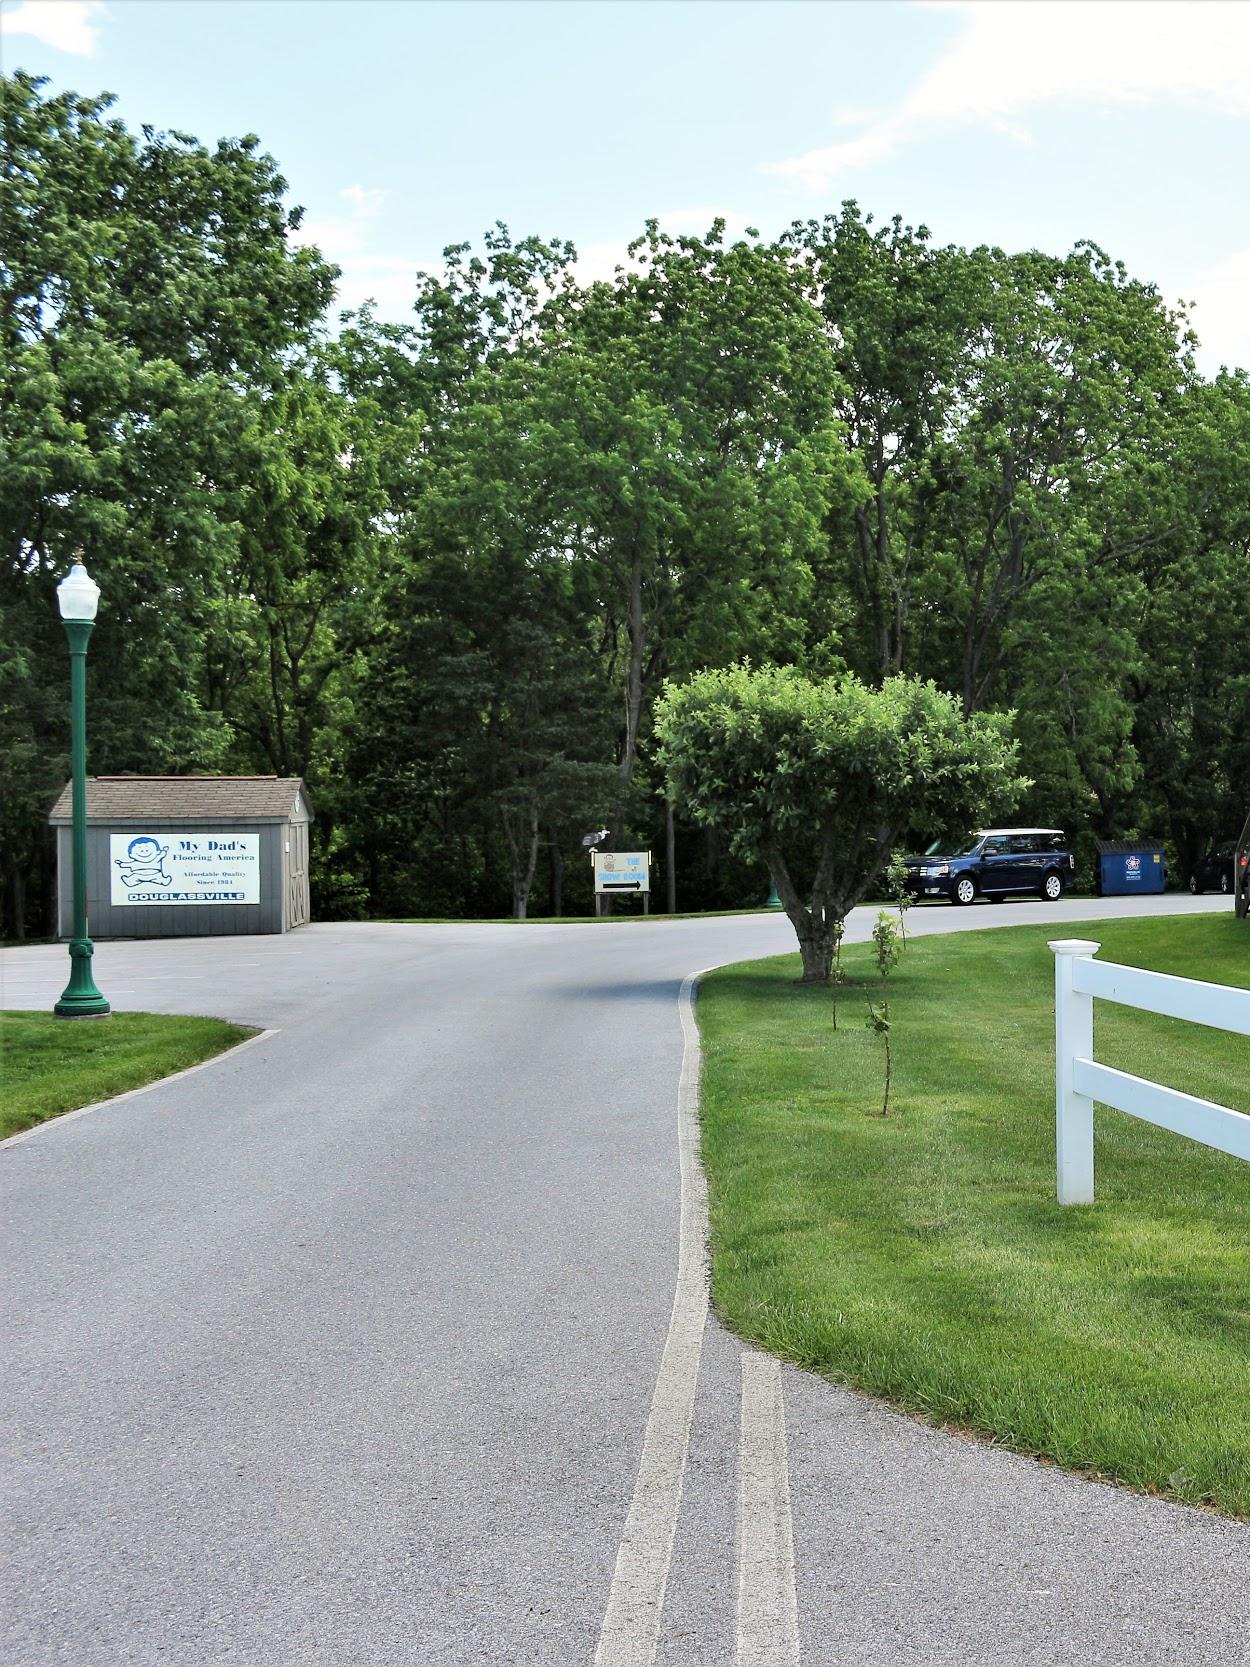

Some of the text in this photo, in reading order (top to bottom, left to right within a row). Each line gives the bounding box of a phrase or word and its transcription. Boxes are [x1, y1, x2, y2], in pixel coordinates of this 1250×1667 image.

[179, 841, 247, 853] My Dad's
[173, 854, 212, 862] Flooring
[129, 893, 244, 901] DOUGLASSVILLE
